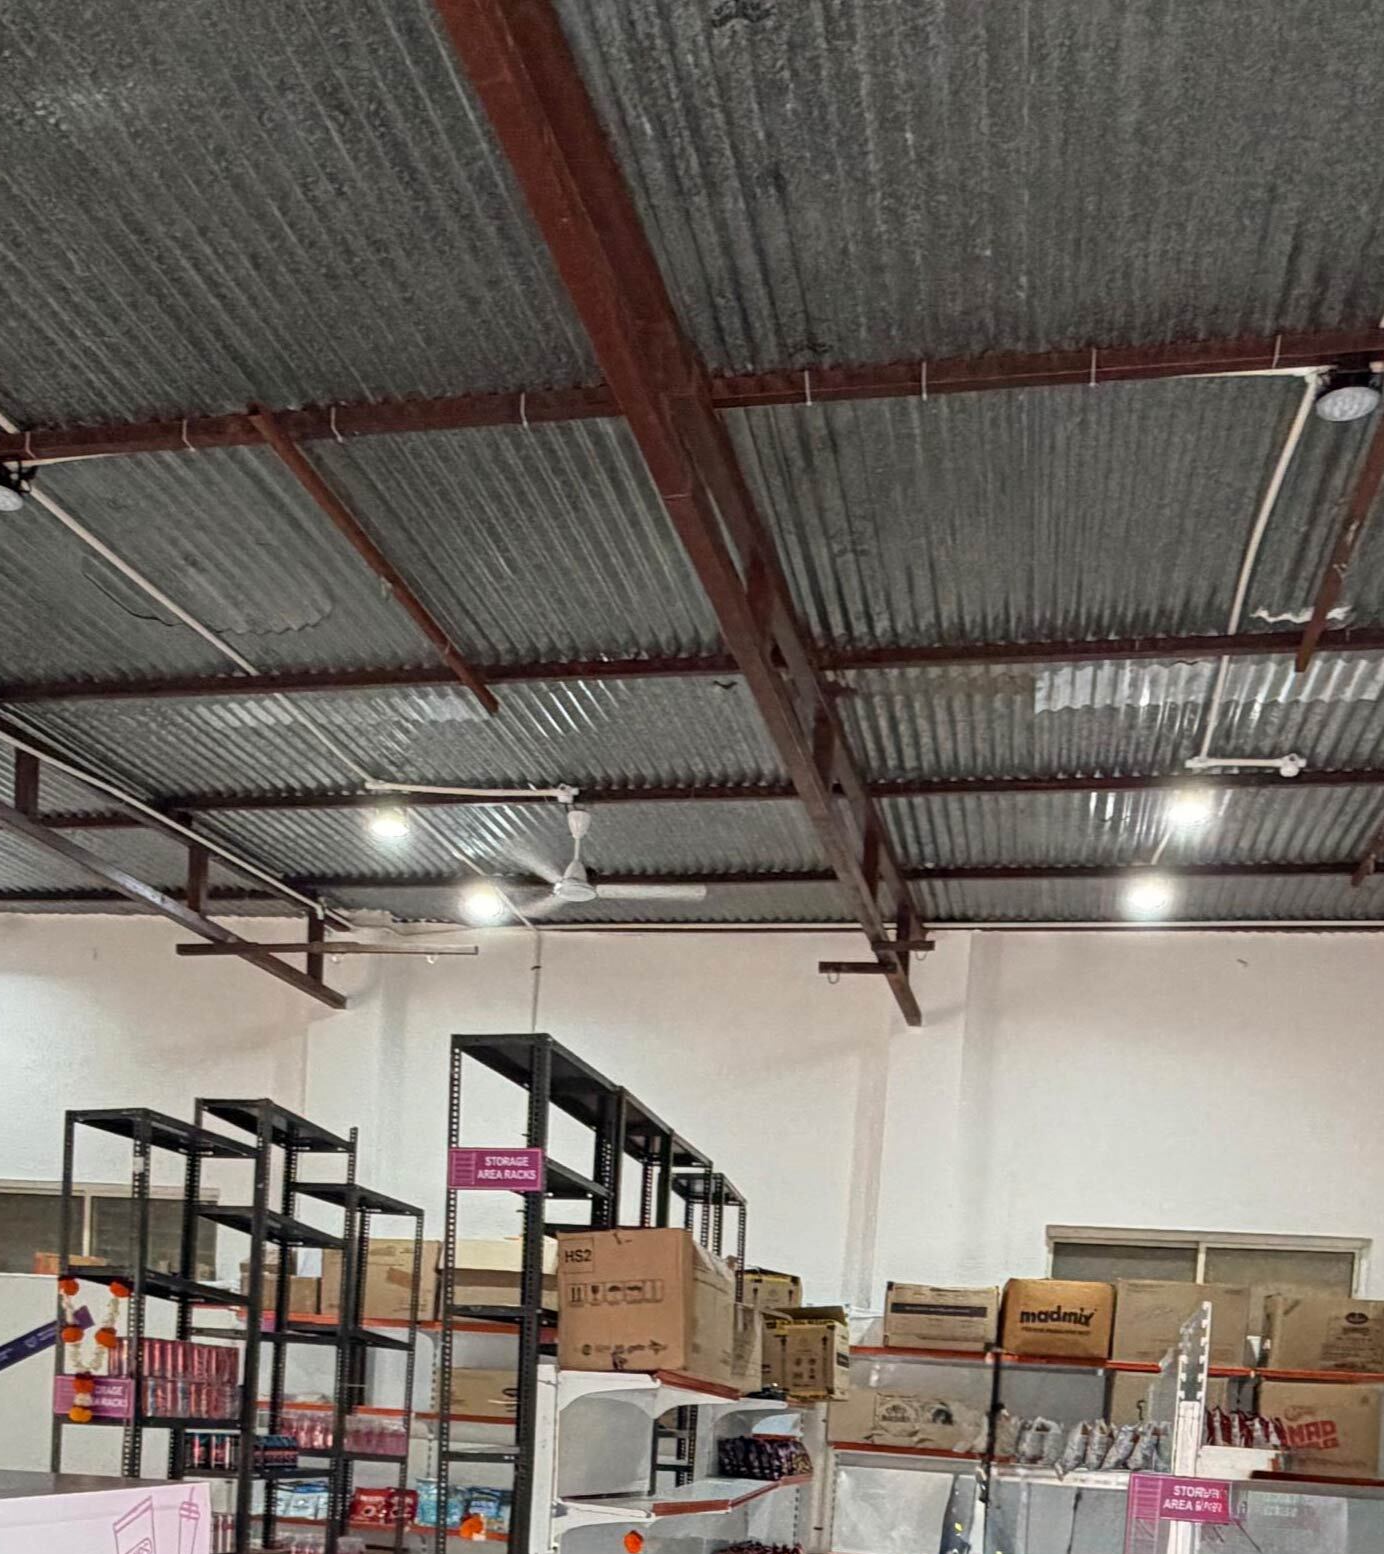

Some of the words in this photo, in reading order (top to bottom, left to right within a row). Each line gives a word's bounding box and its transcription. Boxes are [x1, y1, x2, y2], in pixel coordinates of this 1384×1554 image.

[485, 1156, 529, 1167] STORAGE
[477, 1169, 503, 1180] AREA
[504, 1169, 537, 1180] RACKS
[564, 1249, 593, 1264] HS2
[1163, 1498, 1193, 1512] AREA
